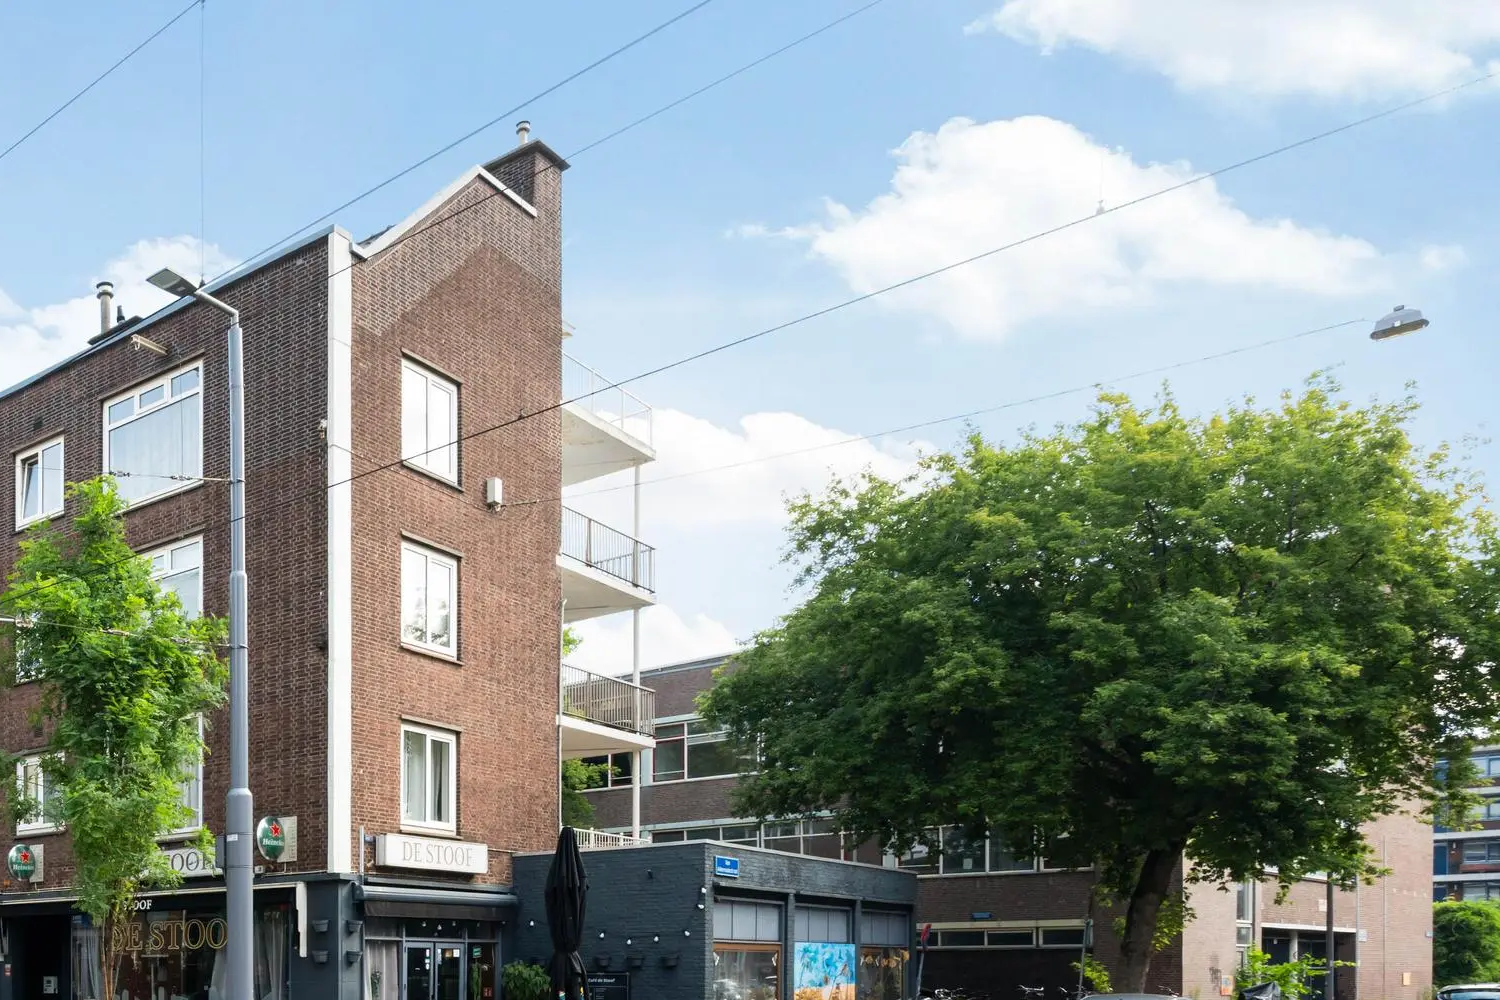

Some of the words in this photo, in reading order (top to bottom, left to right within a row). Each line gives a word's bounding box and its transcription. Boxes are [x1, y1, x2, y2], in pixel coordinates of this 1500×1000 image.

[263, 838, 284, 846] Heineke
[403, 841, 422, 862] DE
[426, 844, 473, 866] STOOF
[123, 899, 152, 910] SOOF
[150, 918, 228, 950] STOO
